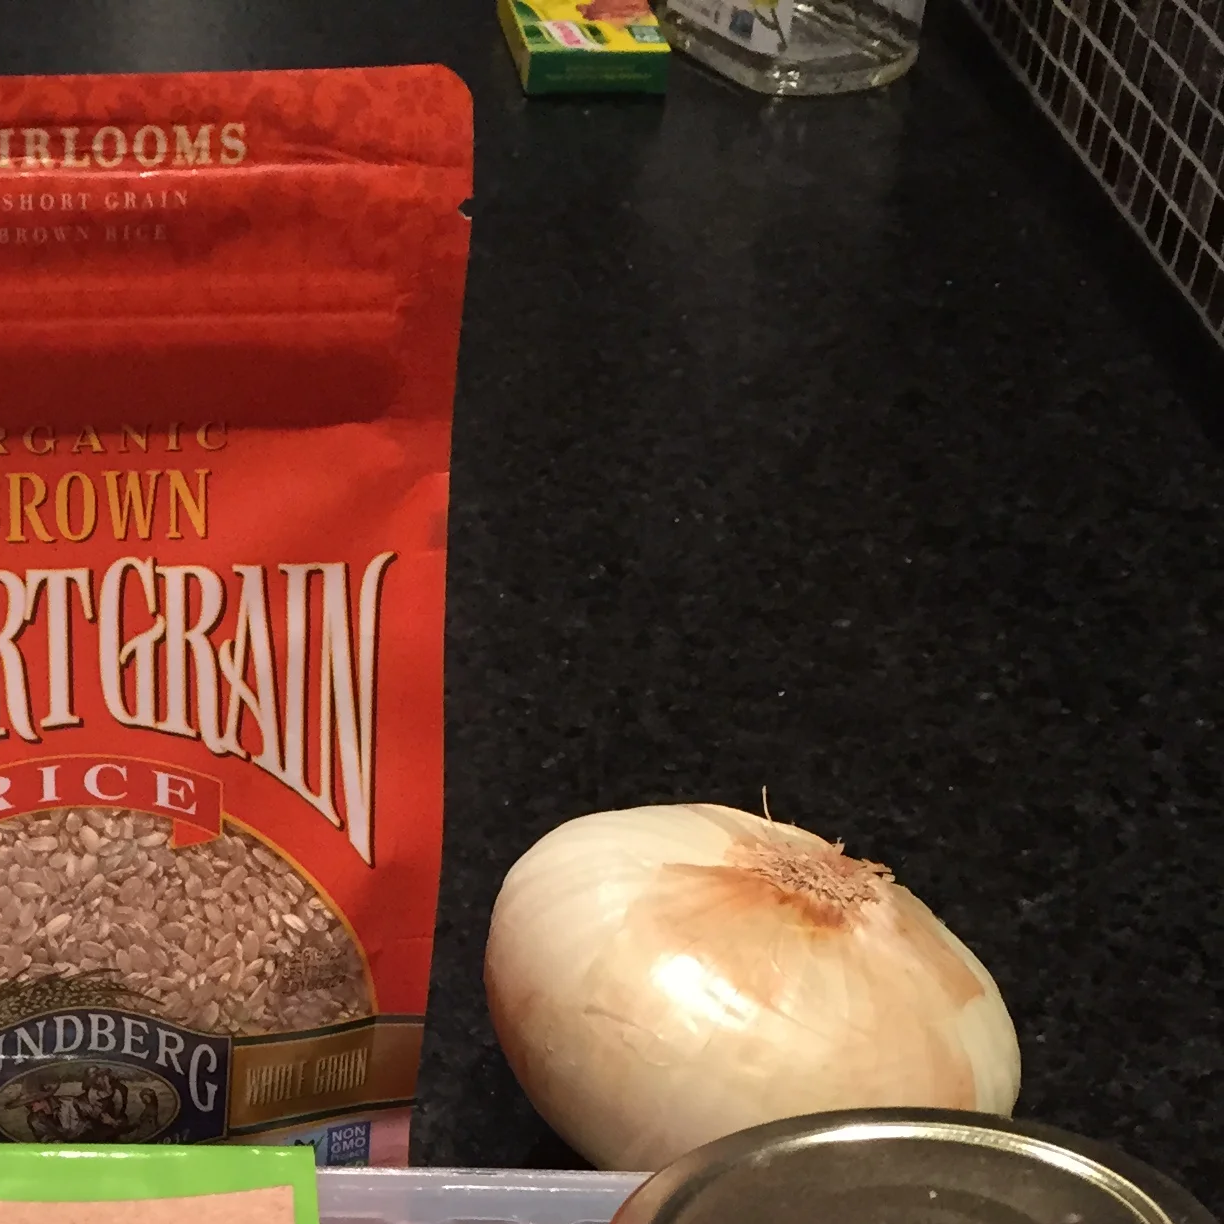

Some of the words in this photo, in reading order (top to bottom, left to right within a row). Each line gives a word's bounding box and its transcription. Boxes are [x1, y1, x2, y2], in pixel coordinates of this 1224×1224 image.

[1, 192, 91, 212] SHORT
[104, 189, 189, 210] GRAIN
[105, 224, 168, 241] RICE
[246, 1061, 308, 1107] WHOLE
[313, 1047, 369, 1094] GRAIN
[331, 1125, 367, 1142] NON
[330, 1137, 366, 1154] GMO
